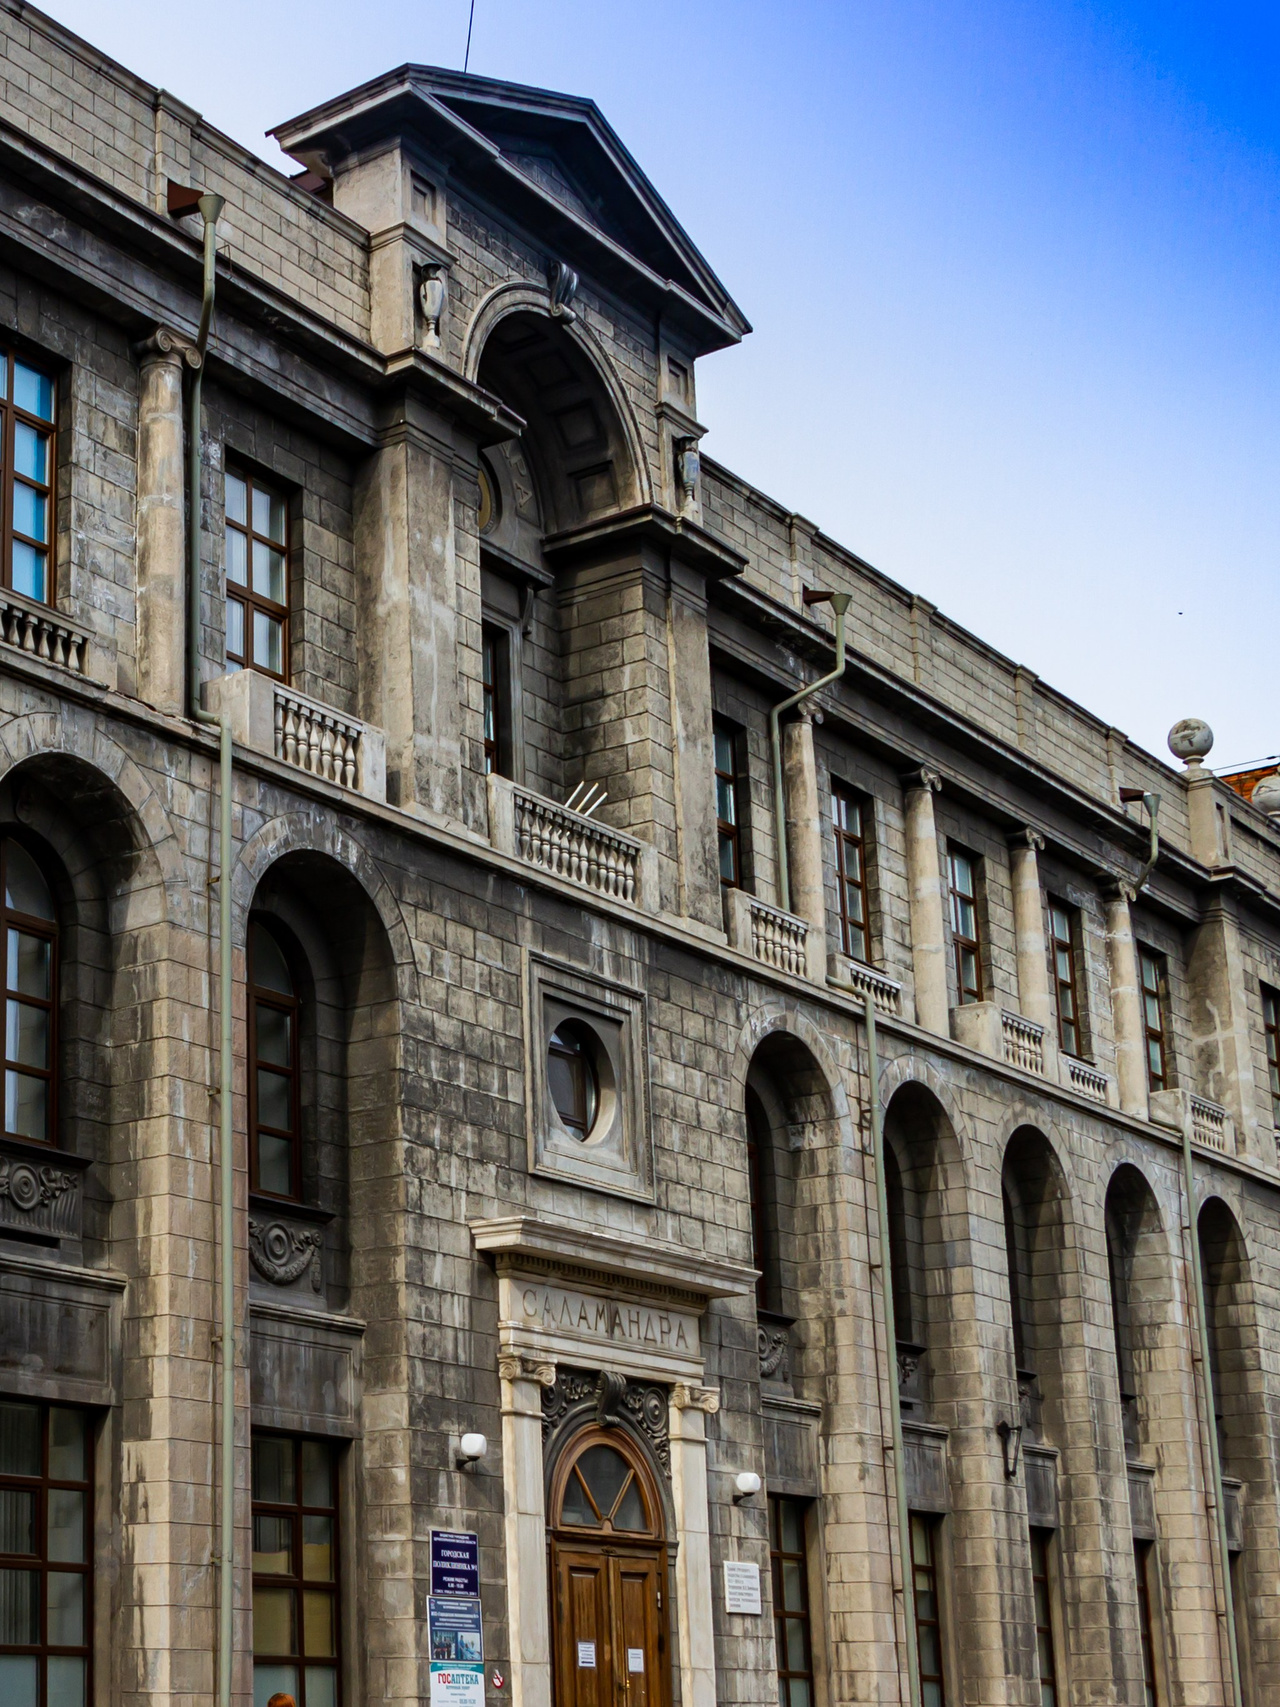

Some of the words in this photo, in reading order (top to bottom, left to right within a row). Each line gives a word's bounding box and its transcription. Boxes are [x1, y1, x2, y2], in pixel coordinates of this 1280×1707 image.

[522, 1288, 689, 1349] САЛАМАНДРА
[441, 1549, 470, 1560] ГОРОДСКАЯ
[437, 1673, 479, 1685] ГОСАПТЕКА
